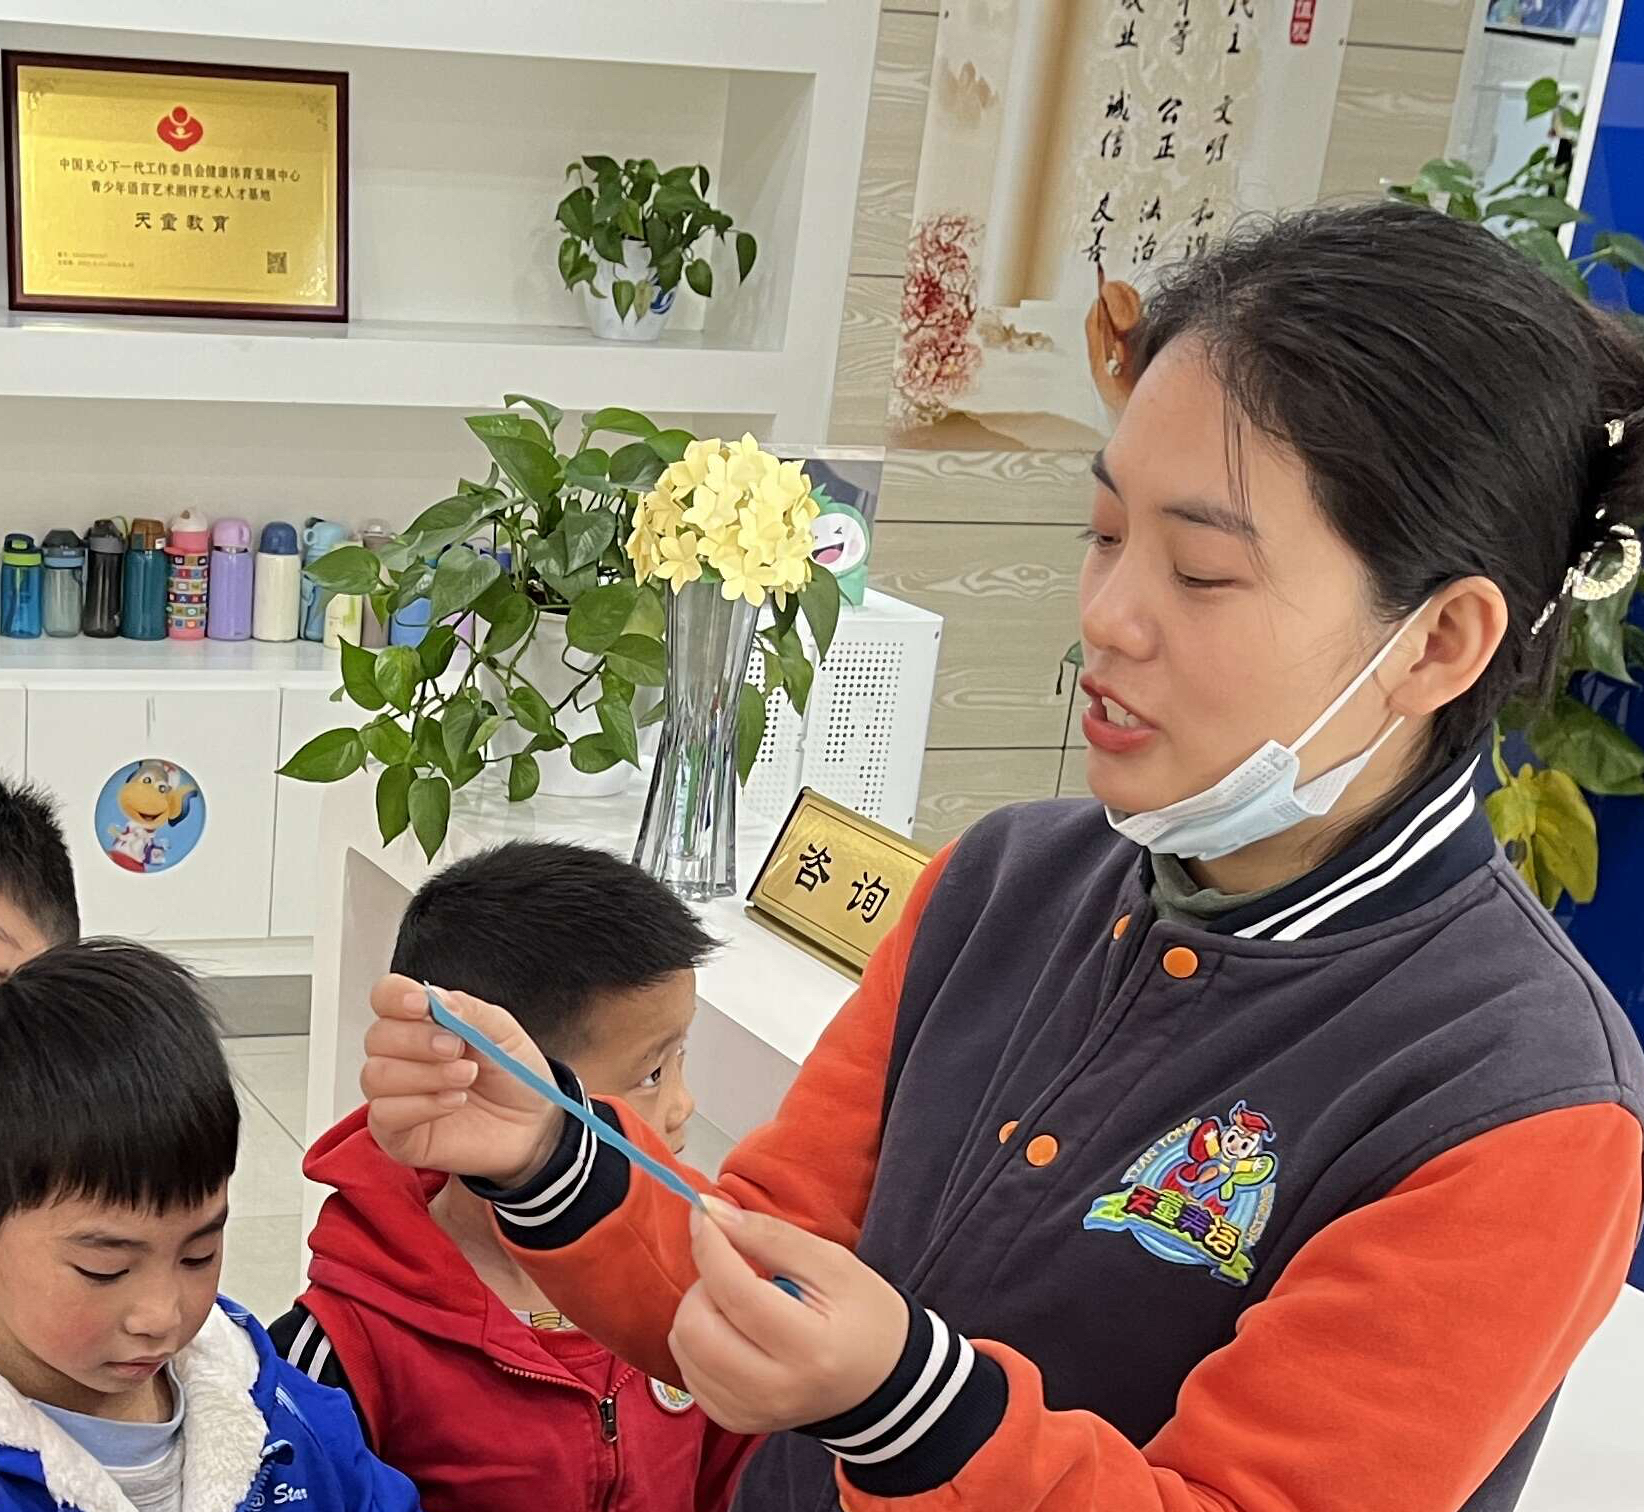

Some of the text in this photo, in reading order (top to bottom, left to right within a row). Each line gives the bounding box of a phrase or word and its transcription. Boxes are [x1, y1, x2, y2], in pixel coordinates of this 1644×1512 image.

[1101, 89, 1131, 158] 诚信
[1153, 96, 1182, 161] 公正
[1206, 95, 1234, 165] 文明
[134, 212, 230, 233] 天童教育
[1082, 192, 1115, 262] 友善
[1132, 197, 1160, 263] 法治
[794, 842, 890, 923] 咨询
[274, 1483, 308, 1504] Star
